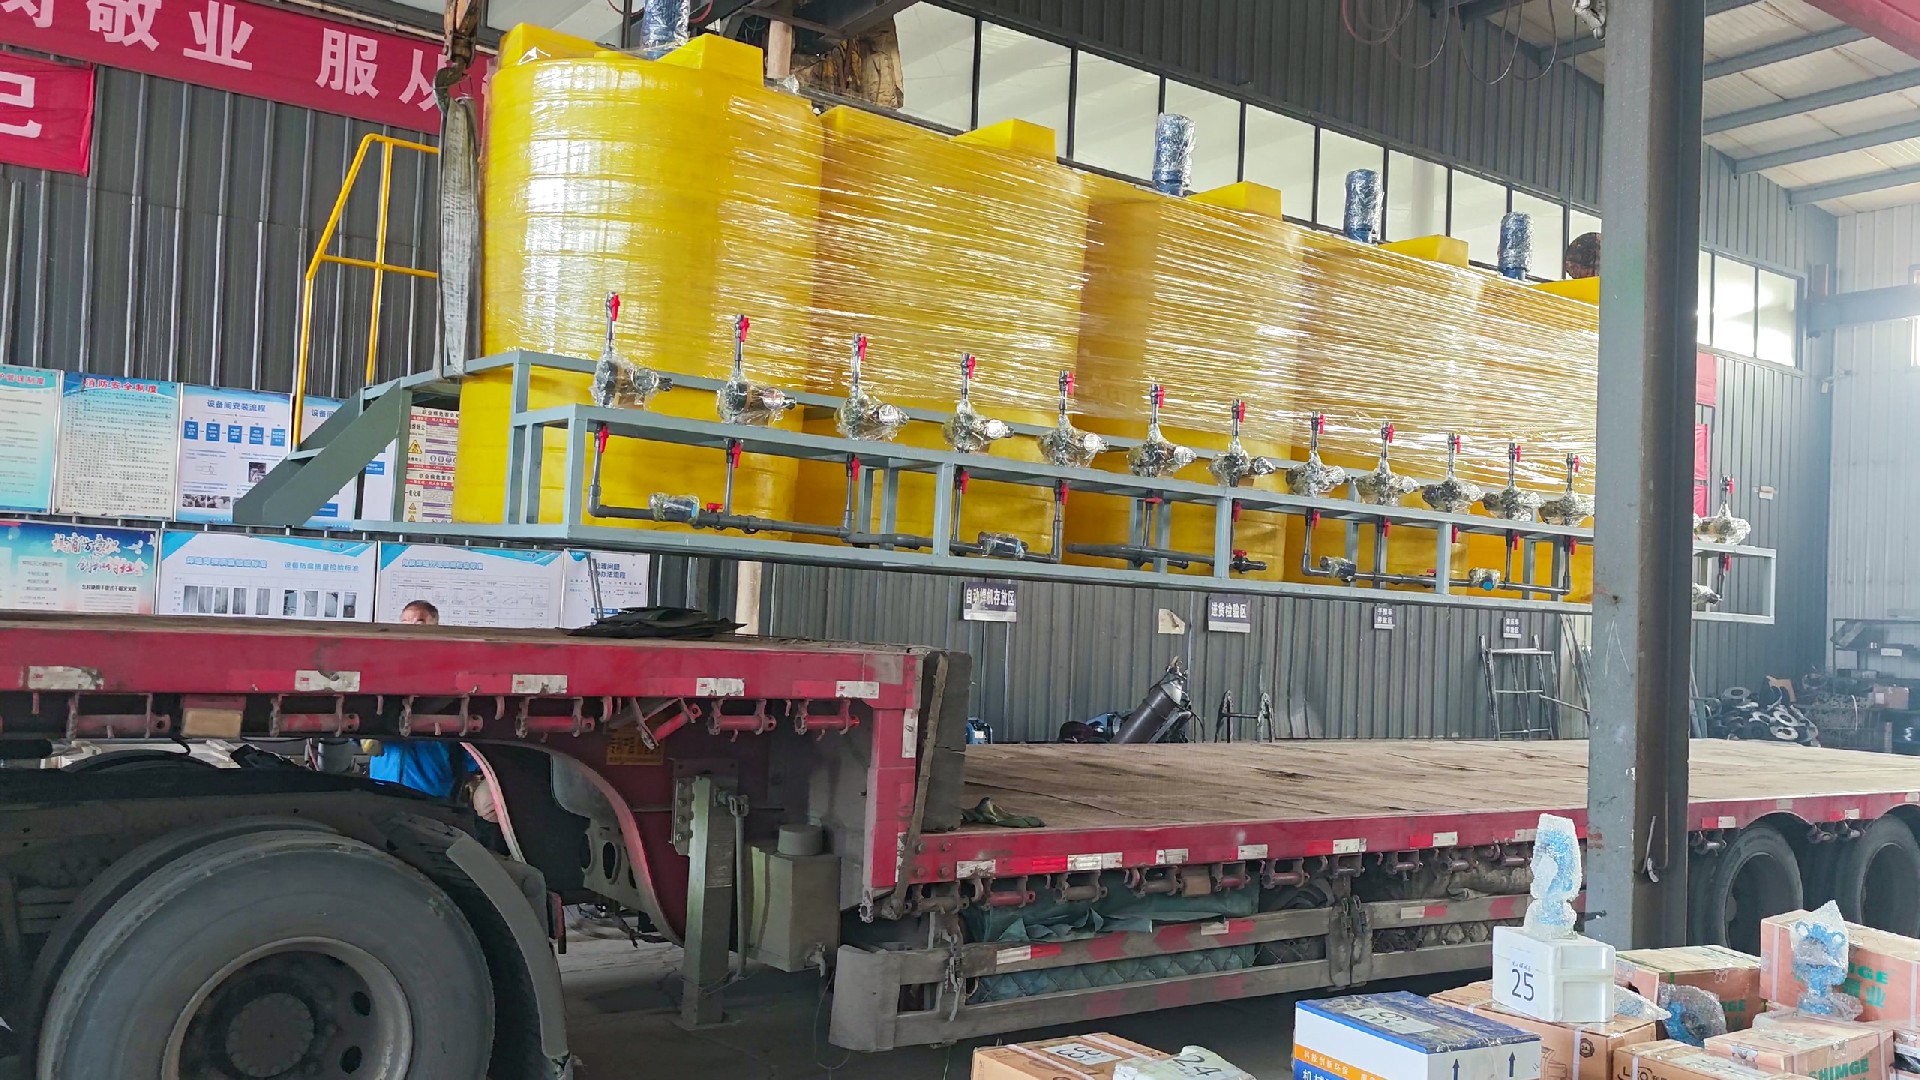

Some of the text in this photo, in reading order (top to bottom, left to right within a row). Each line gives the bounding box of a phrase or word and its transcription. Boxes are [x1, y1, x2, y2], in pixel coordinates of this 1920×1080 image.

[85, 377, 158, 394] 消防安全制度
[207, 399, 266, 412] 设备间安装流程
[966, 587, 1015, 606] 自动焊机存放区
[1211, 601, 1247, 618] 进货检验区
[1511, 968, 1535, 1002] 25
[1173, 1054, 1222, 1076] 24
[1303, 1050, 1349, 1076] 科技创新环保
